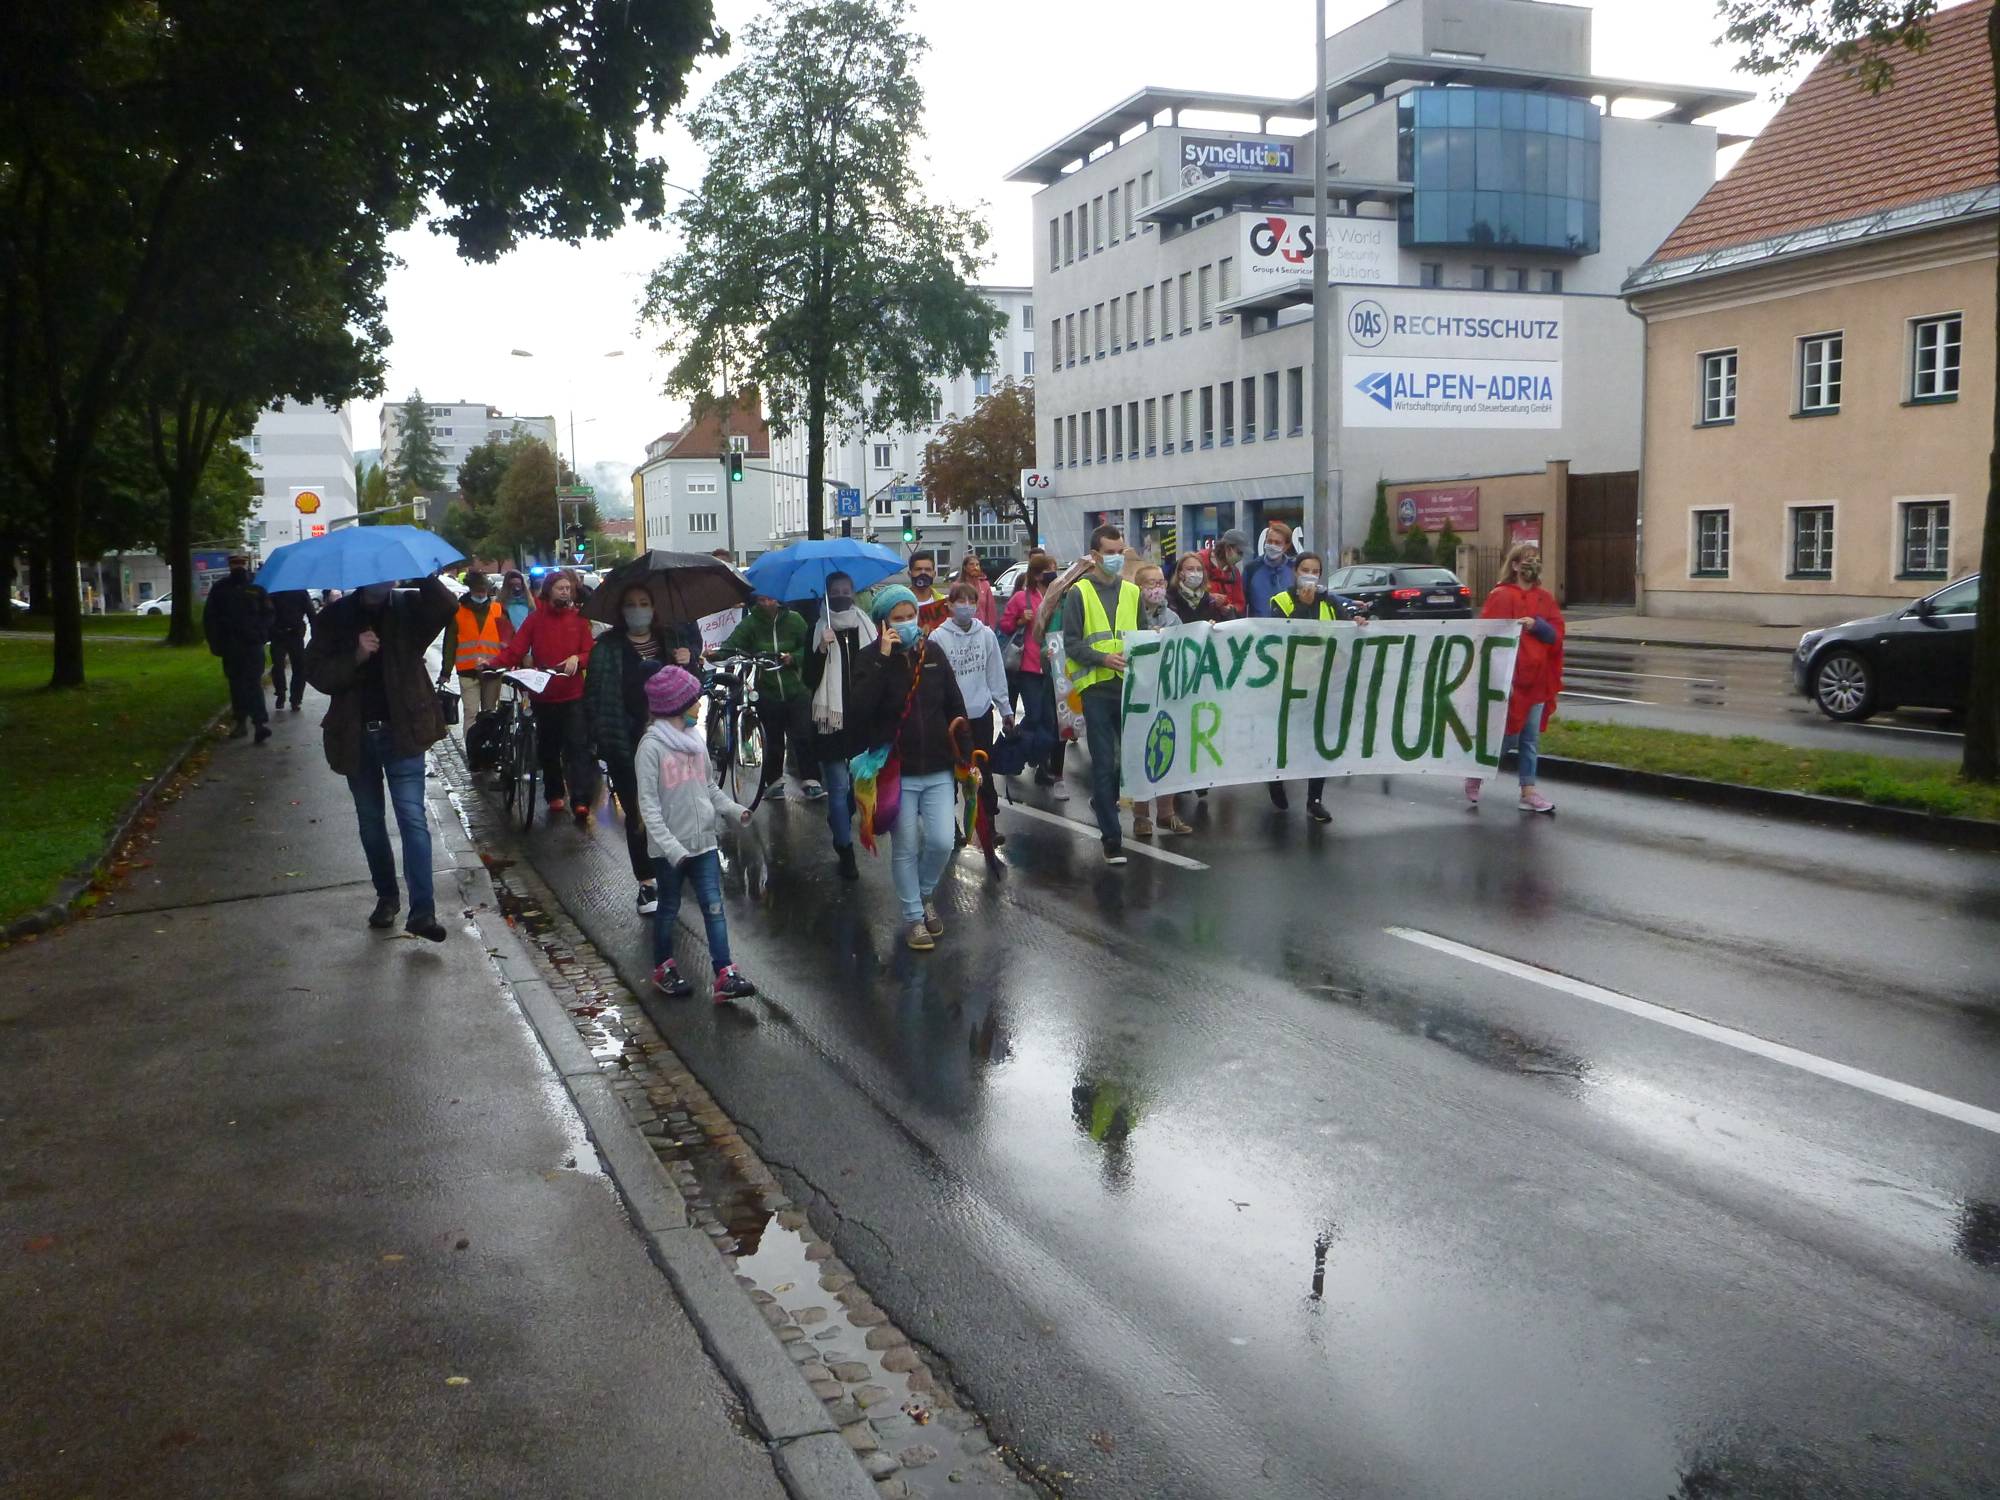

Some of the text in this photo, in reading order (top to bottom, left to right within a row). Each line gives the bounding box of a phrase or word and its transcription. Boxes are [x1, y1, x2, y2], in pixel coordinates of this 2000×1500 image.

[1250, 217, 1314, 263] G4S
[1338, 227, 1381, 245] World
[1338, 246, 1379, 263] Security
[1252, 265, 1275, 275] Group
[1328, 264, 1381, 280] olutions
[1355, 310, 1382, 338] DAS
[1394, 314, 1558, 340] RECHTSSCHUTZ
[1393, 372, 1553, 401] ALPEN-ADRIA
[1394, 401, 1552, 415] Wirtschaftsprüfung und Steuerberatung GmbH
[1121, 634, 1283, 714] FRIDAYS
[1276, 633, 1518, 769] FUTURE
